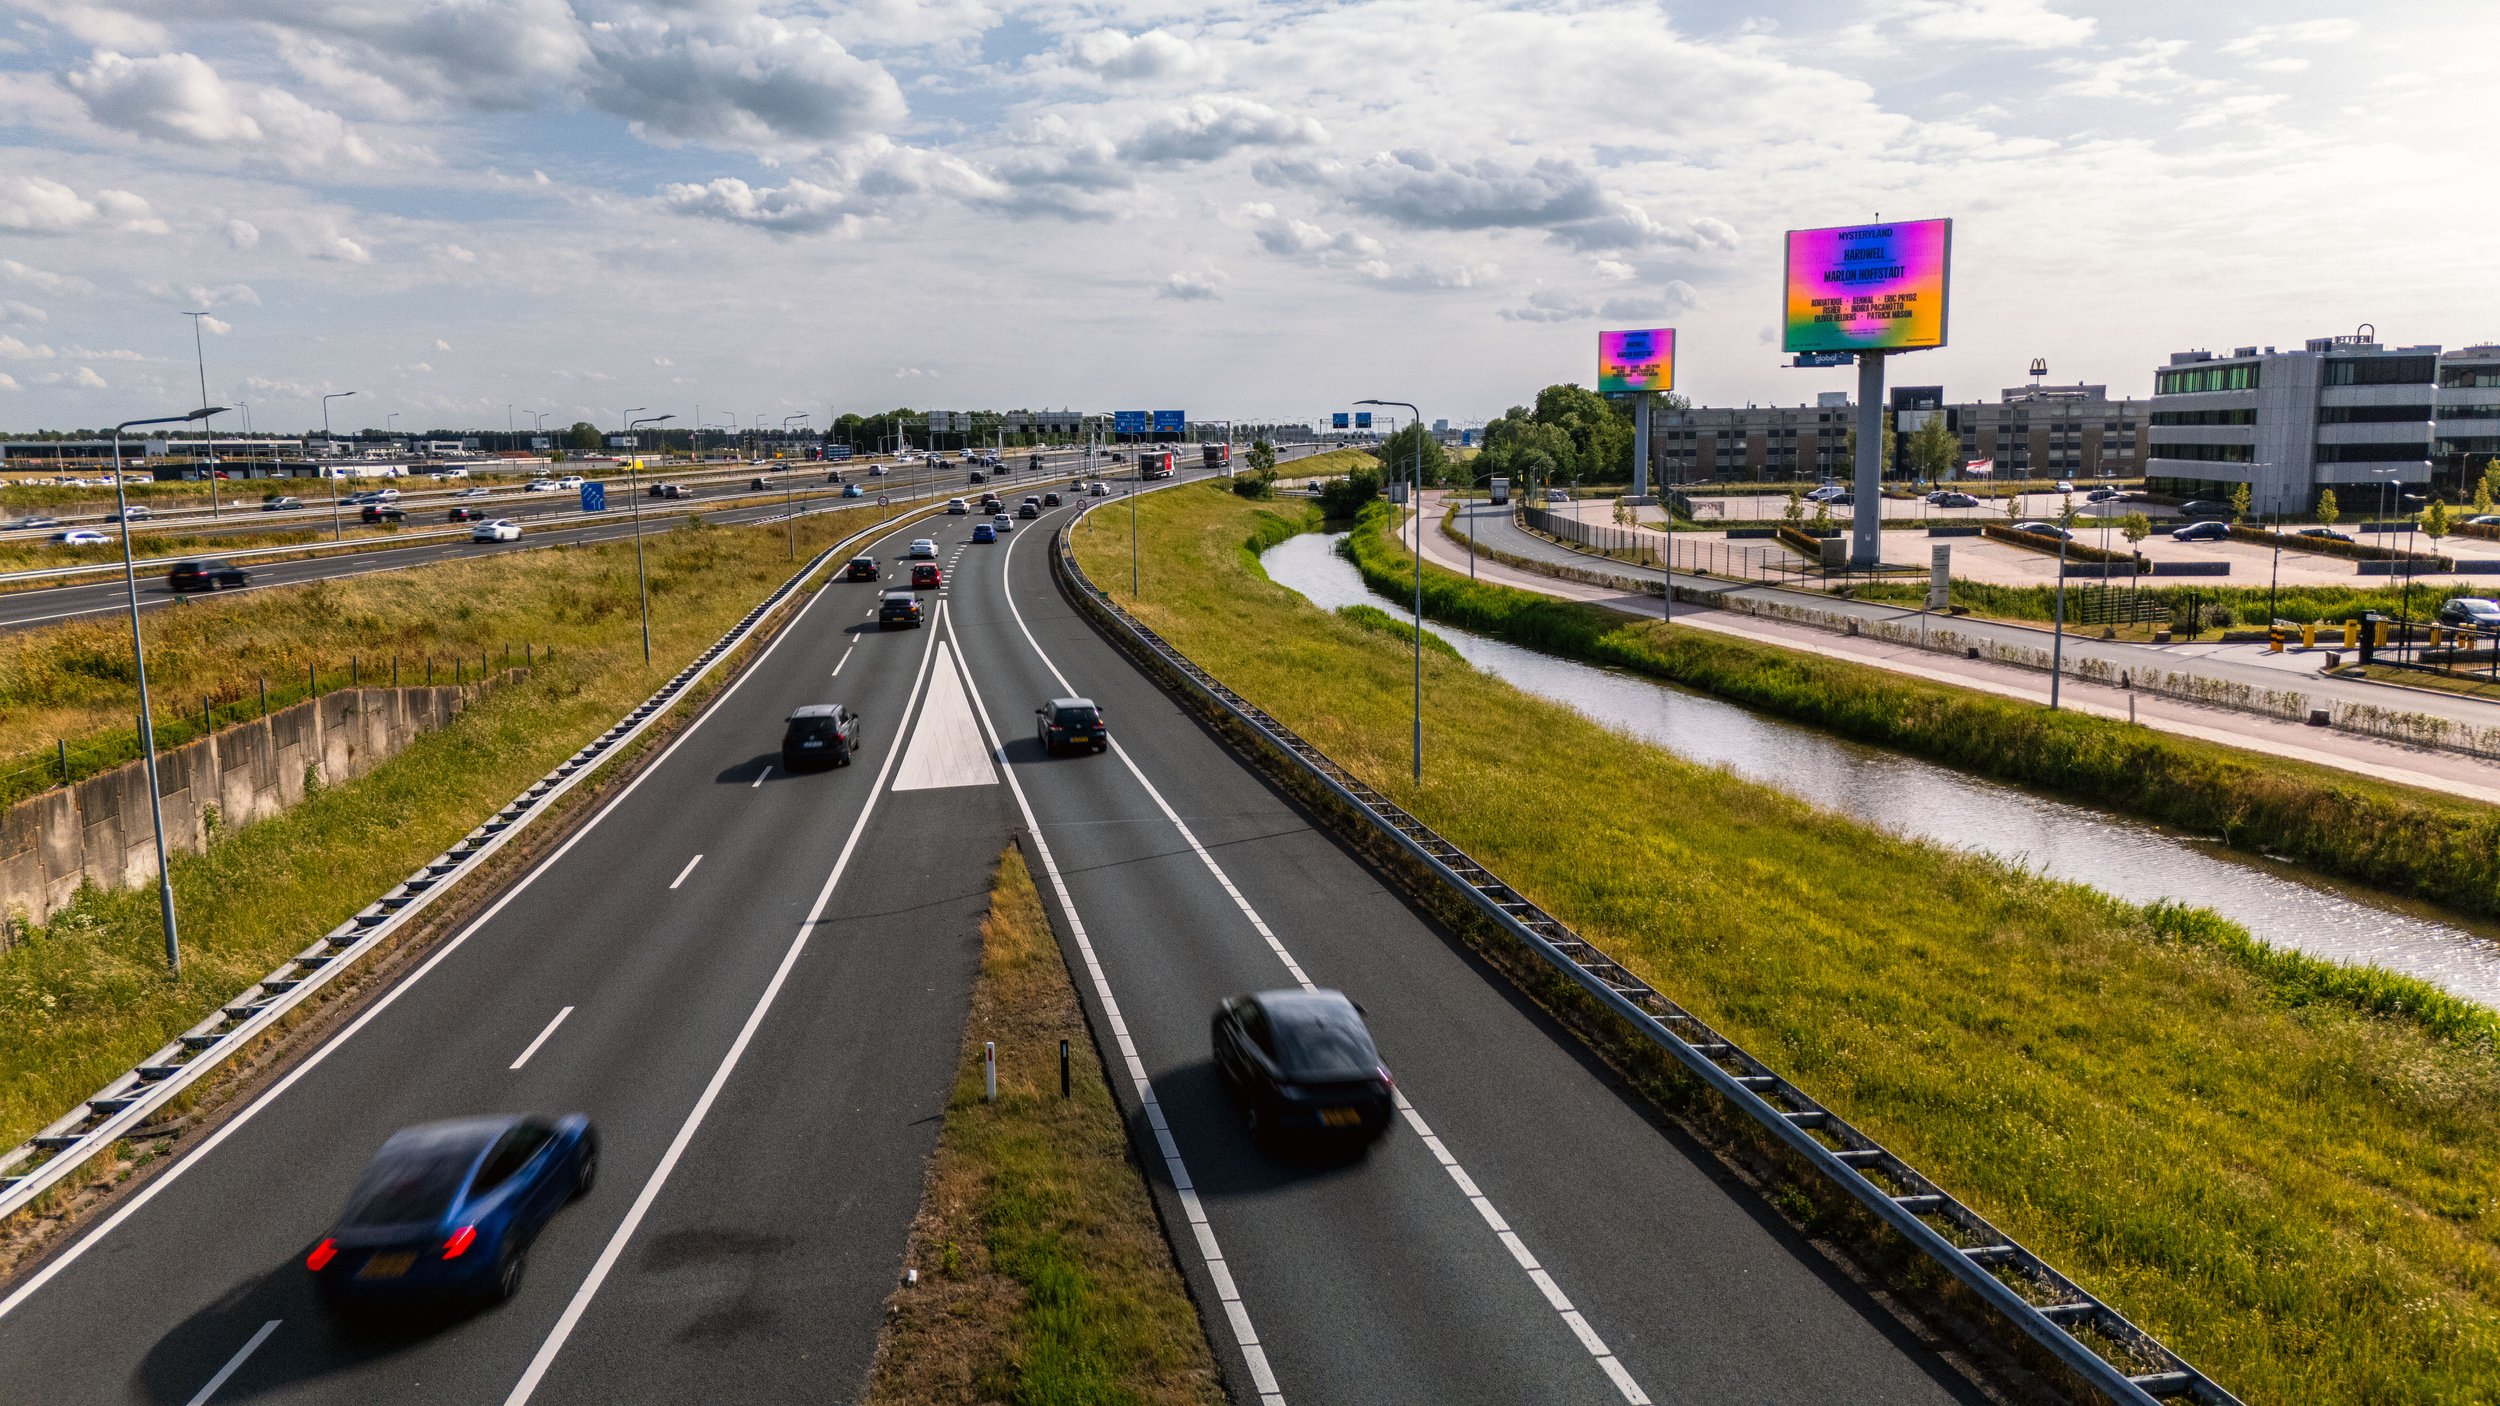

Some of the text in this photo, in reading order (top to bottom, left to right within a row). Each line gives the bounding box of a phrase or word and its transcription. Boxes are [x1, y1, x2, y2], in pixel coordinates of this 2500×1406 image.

[1838, 228, 1893, 241] MYSTERYLAND
[1844, 247, 1885, 262] HARDWELL
[1824, 265, 1906, 283] MARLON HOFFSTADT
[1884, 294, 1897, 303] ERIC
[1823, 306, 1841, 315] FISHER
[1867, 311, 1891, 320] PATRICK
[1891, 310, 1913, 319] MASON
[1814, 353, 1837, 364] global
